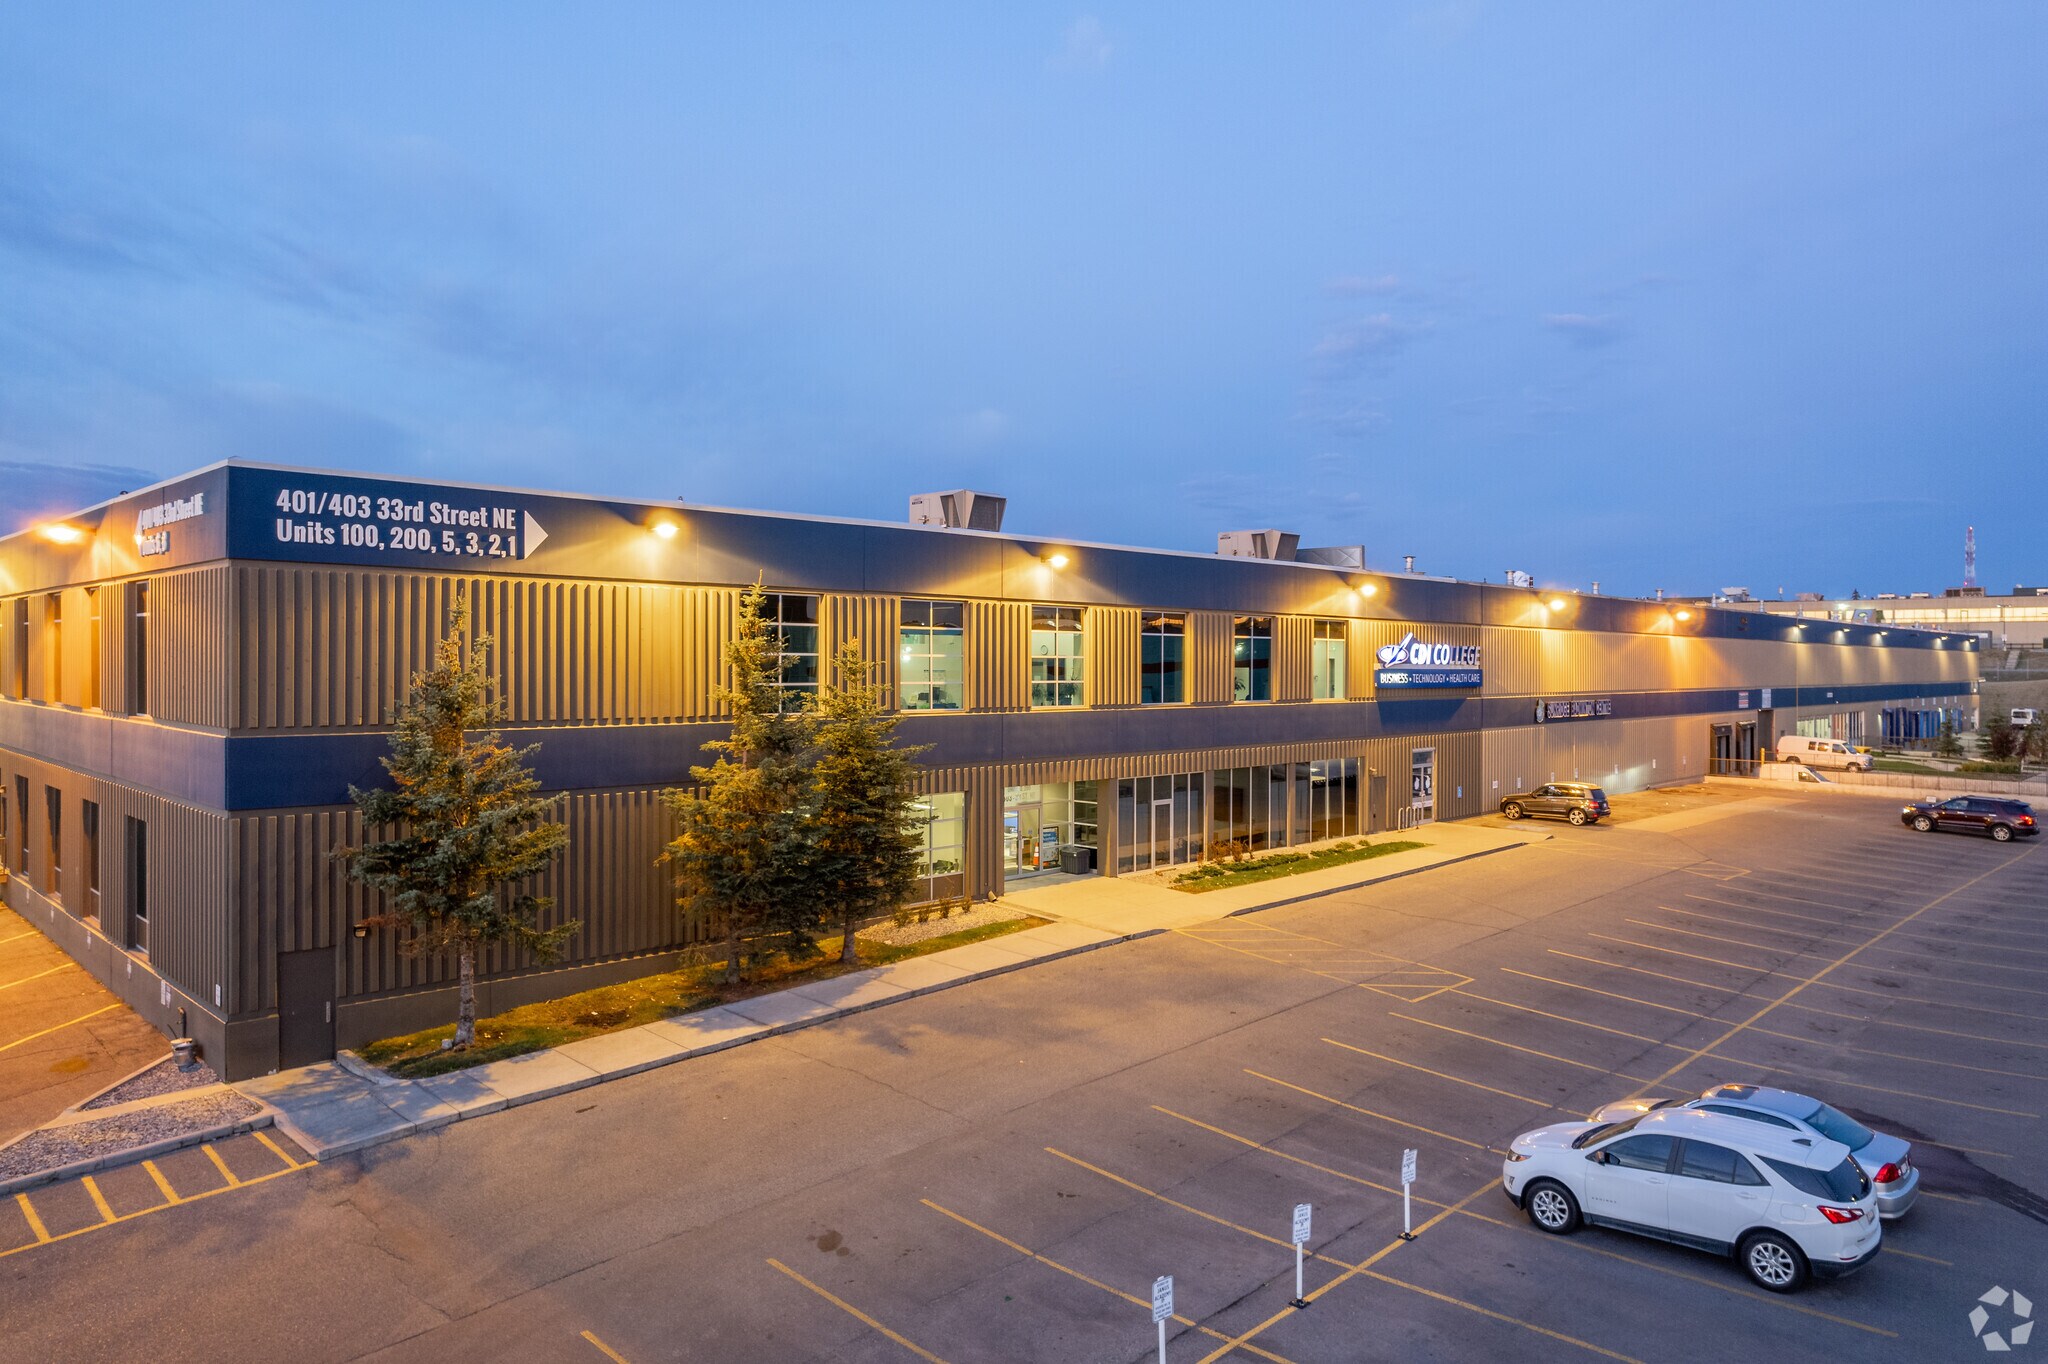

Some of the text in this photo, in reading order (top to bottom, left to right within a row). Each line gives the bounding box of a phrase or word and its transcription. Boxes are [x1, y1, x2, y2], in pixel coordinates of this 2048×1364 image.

[276, 488, 516, 530] 401/403 33rd Street NE
[276, 519, 335, 545] Units
[341, 523, 385, 550] 100,
[390, 527, 437, 553] 200,
[442, 530, 461, 555] 5,
[466, 532, 484, 556] 3,
[1410, 643, 1480, 666] CDI COLLEGE
[1380, 672, 1480, 683] BUSINESS TECHNOLOGY HEALTH CARE
